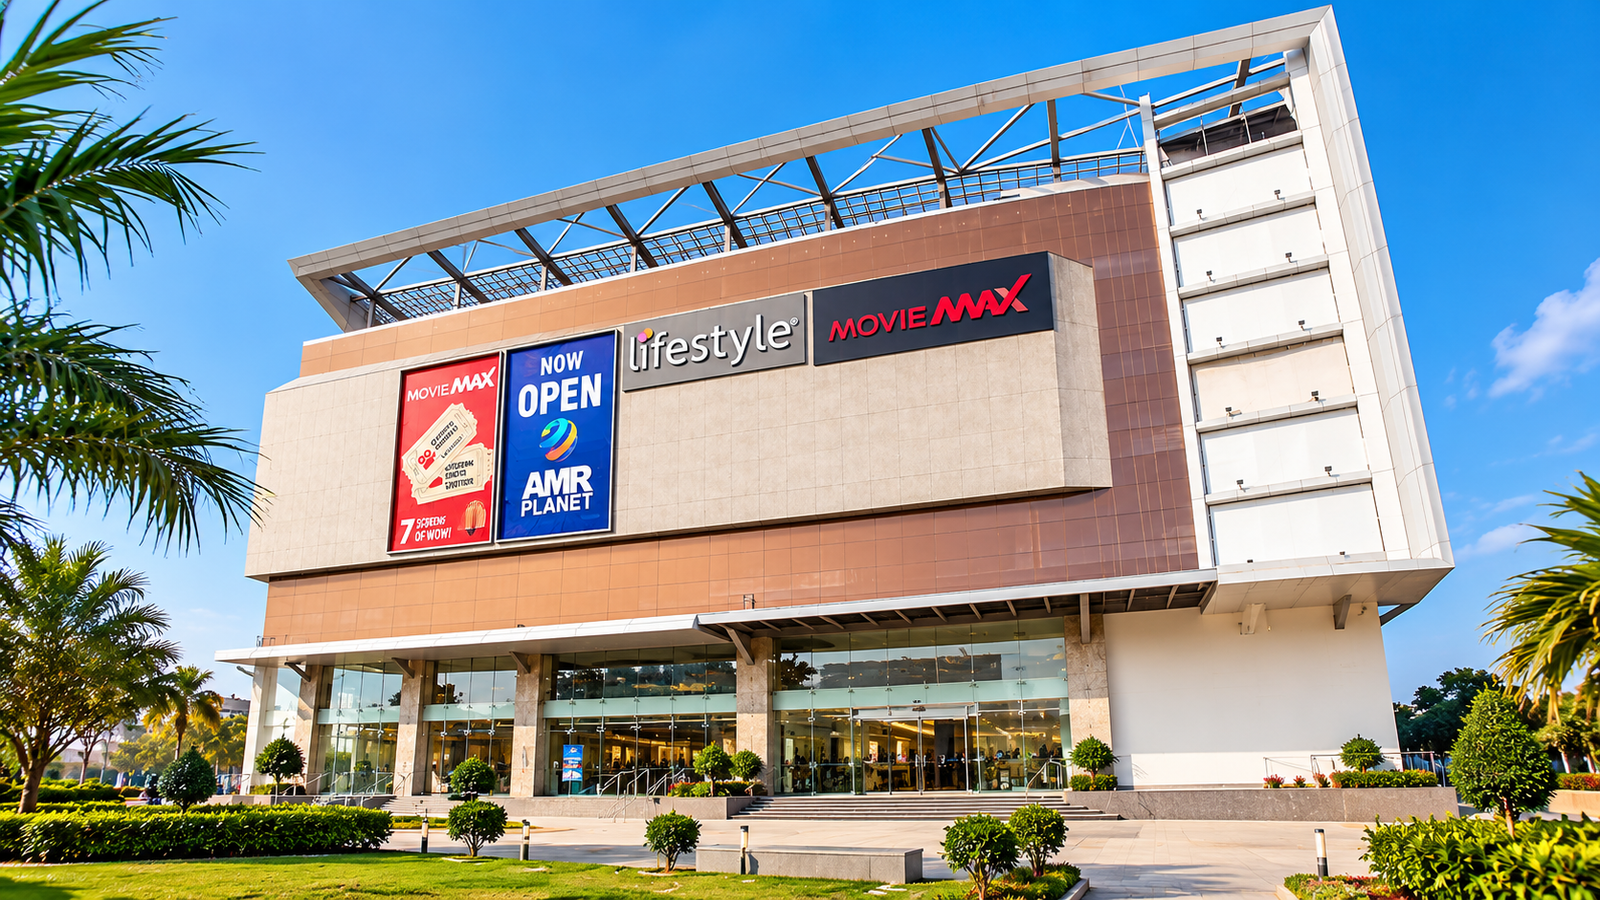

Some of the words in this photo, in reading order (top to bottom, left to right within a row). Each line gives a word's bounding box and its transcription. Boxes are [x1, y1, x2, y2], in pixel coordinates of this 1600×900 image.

[541, 350, 583, 375] NOW
[518, 373, 602, 417] OPEN
[522, 465, 593, 499] AMR
[521, 492, 593, 516] PLANET
[400, 518, 415, 544] 7
